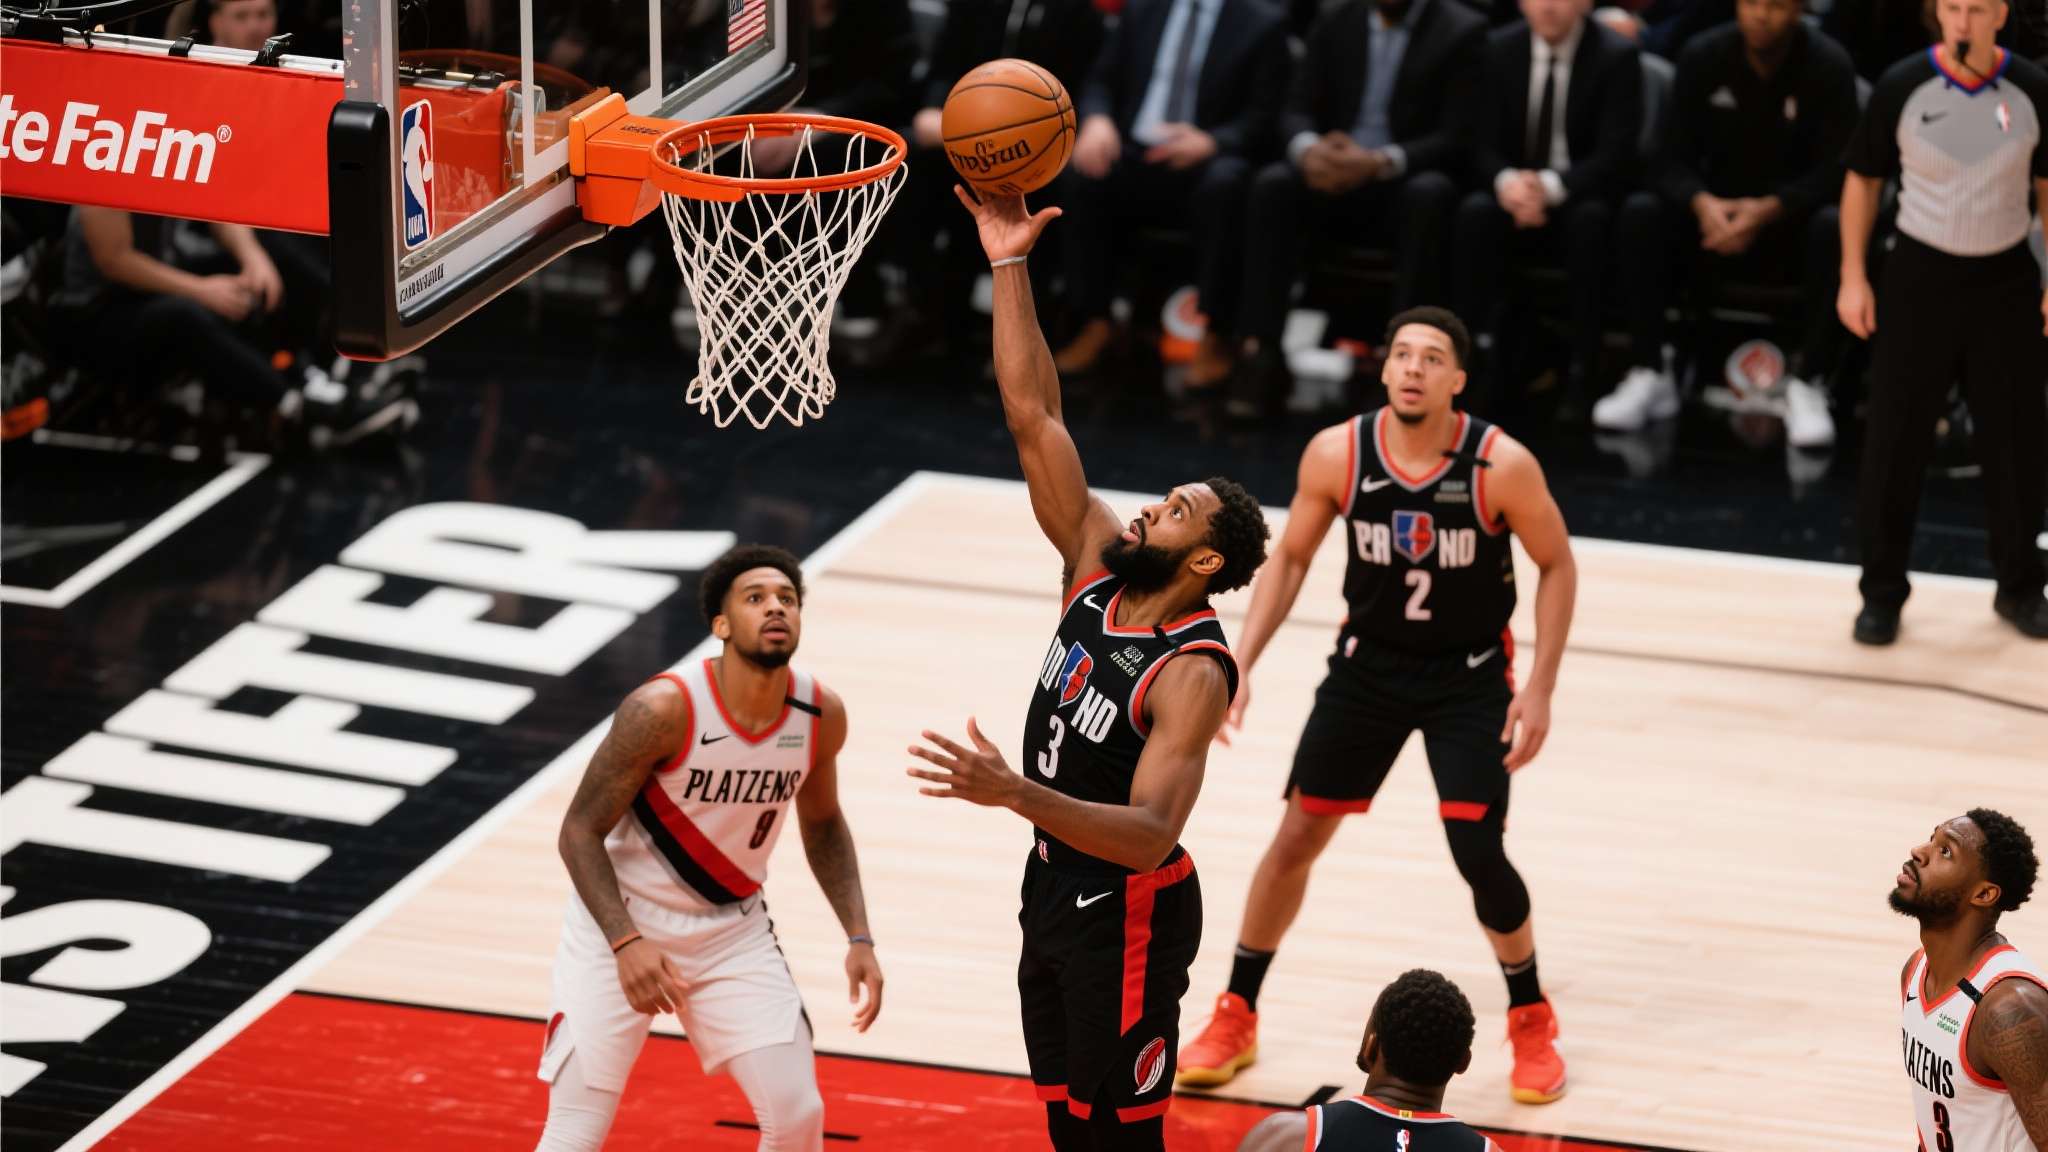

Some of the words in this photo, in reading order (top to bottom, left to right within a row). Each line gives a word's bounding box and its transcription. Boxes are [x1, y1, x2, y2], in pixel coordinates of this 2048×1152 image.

[1405, 569, 1432, 621] 2
[1037, 714, 1065, 779] 3
[683, 768, 802, 804] PLATZENS
